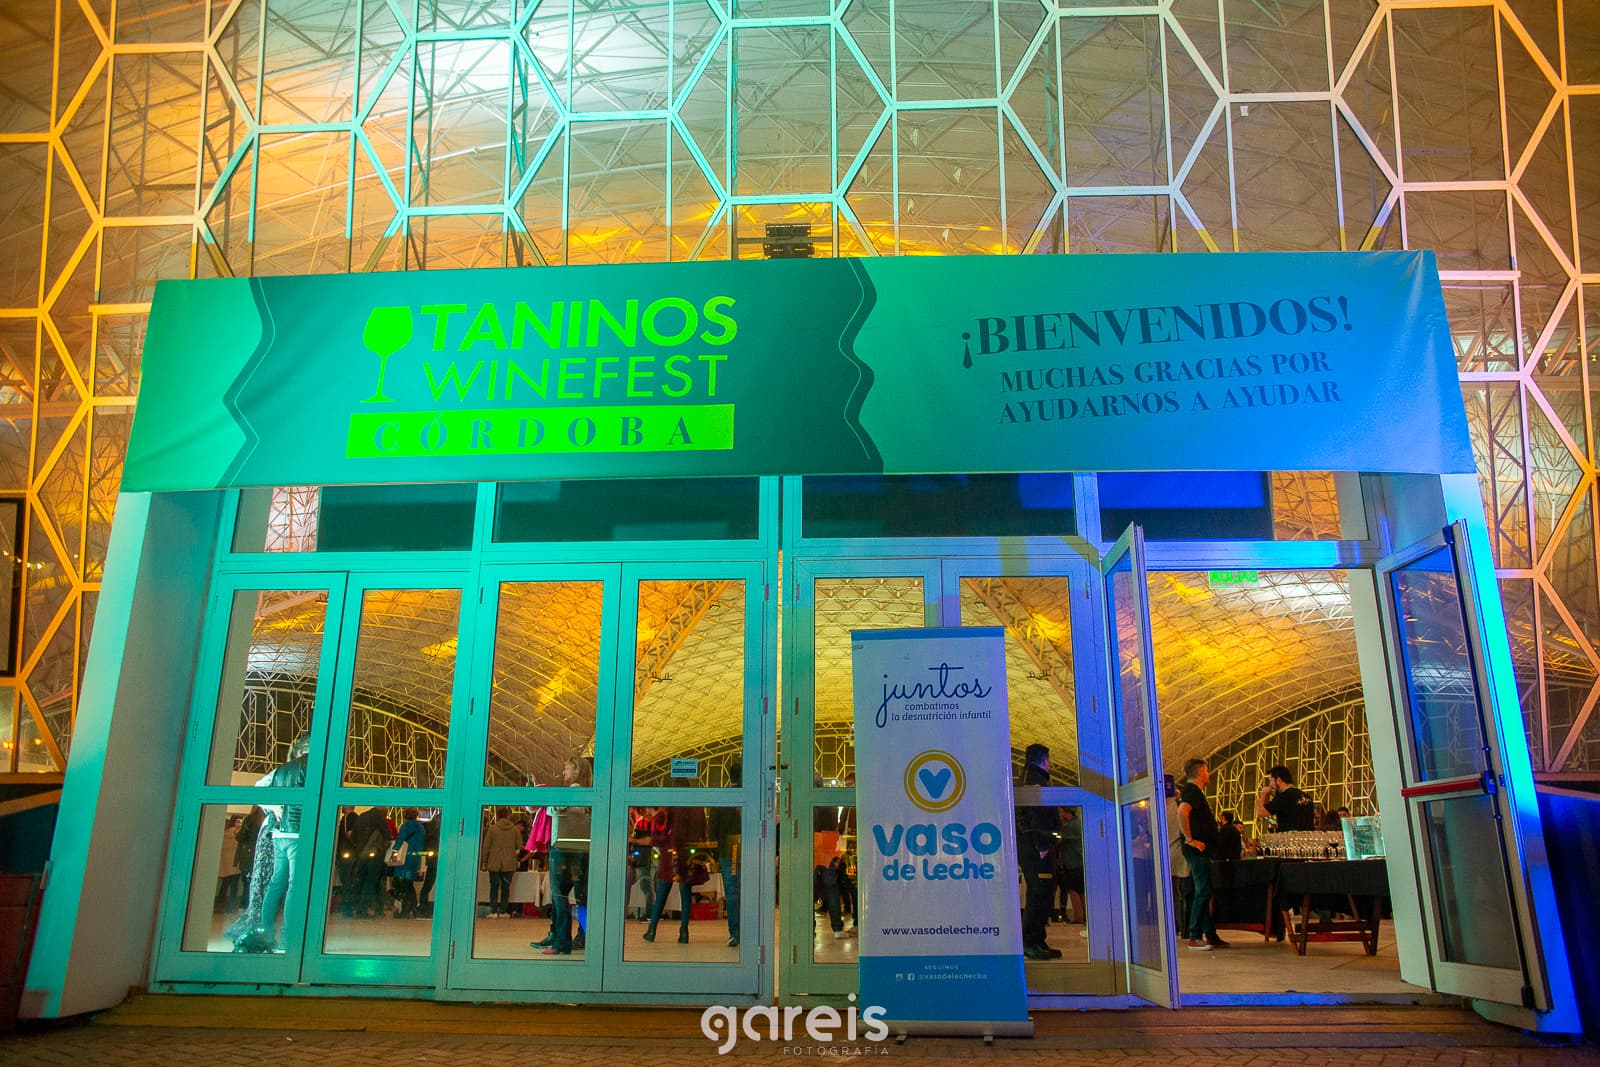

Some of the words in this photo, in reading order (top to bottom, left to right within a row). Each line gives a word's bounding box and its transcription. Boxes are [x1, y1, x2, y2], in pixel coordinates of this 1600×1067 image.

[419, 295, 738, 352] TANINOS
[961, 295, 1354, 369] ¡BIENVENIDOS!
[422, 354, 728, 401] WINEFEST
[1001, 364, 1124, 393] MUCHAS
[1134, 355, 1263, 385] GRACIAS
[1270, 351, 1332, 375] POR
[999, 391, 1180, 425] AYUDARNOS
[1190, 387, 1211, 411] A
[1222, 381, 1343, 409] AYUDAR
[373, 413, 694, 451] CÓRDOBA
[875, 662, 992, 728] juntos
[904, 702, 960, 710] combatimos
[891, 710, 900, 721] la
[903, 710, 957, 721] desnutrición
[959, 710, 992, 721] infantil
[872, 822, 1002, 857] vaso
[882, 858, 916, 881] de
[922, 858, 994, 880] leche
[881, 924, 1000, 937] www.vasodeleche.org
